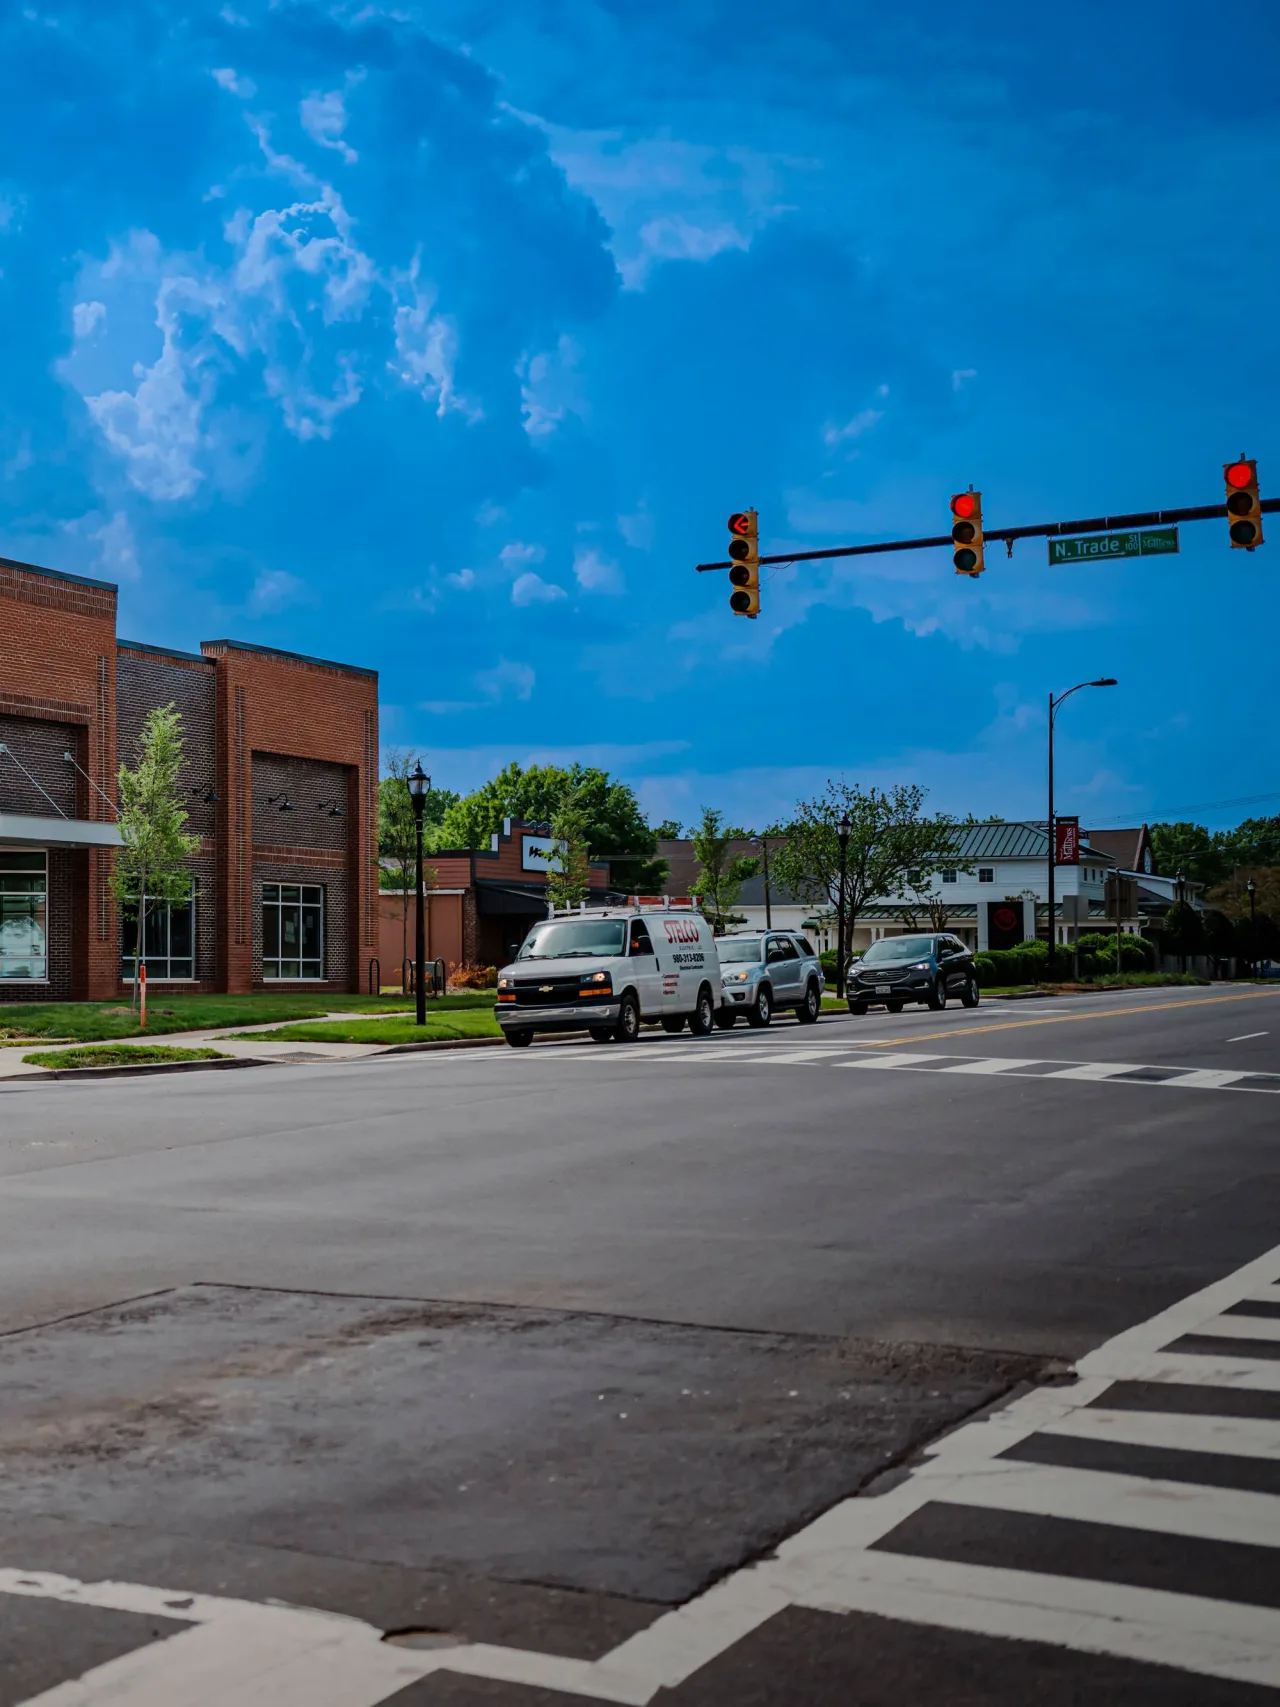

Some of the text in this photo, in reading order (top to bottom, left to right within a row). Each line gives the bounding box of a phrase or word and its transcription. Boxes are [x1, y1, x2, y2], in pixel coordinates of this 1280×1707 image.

[1055, 538, 1119, 557] N. Trade
[1125, 542, 1138, 551] 100
[1129, 534, 1137, 543] St
[1063, 828, 1073, 860] Matthews
[663, 920, 699, 944] STELCO
